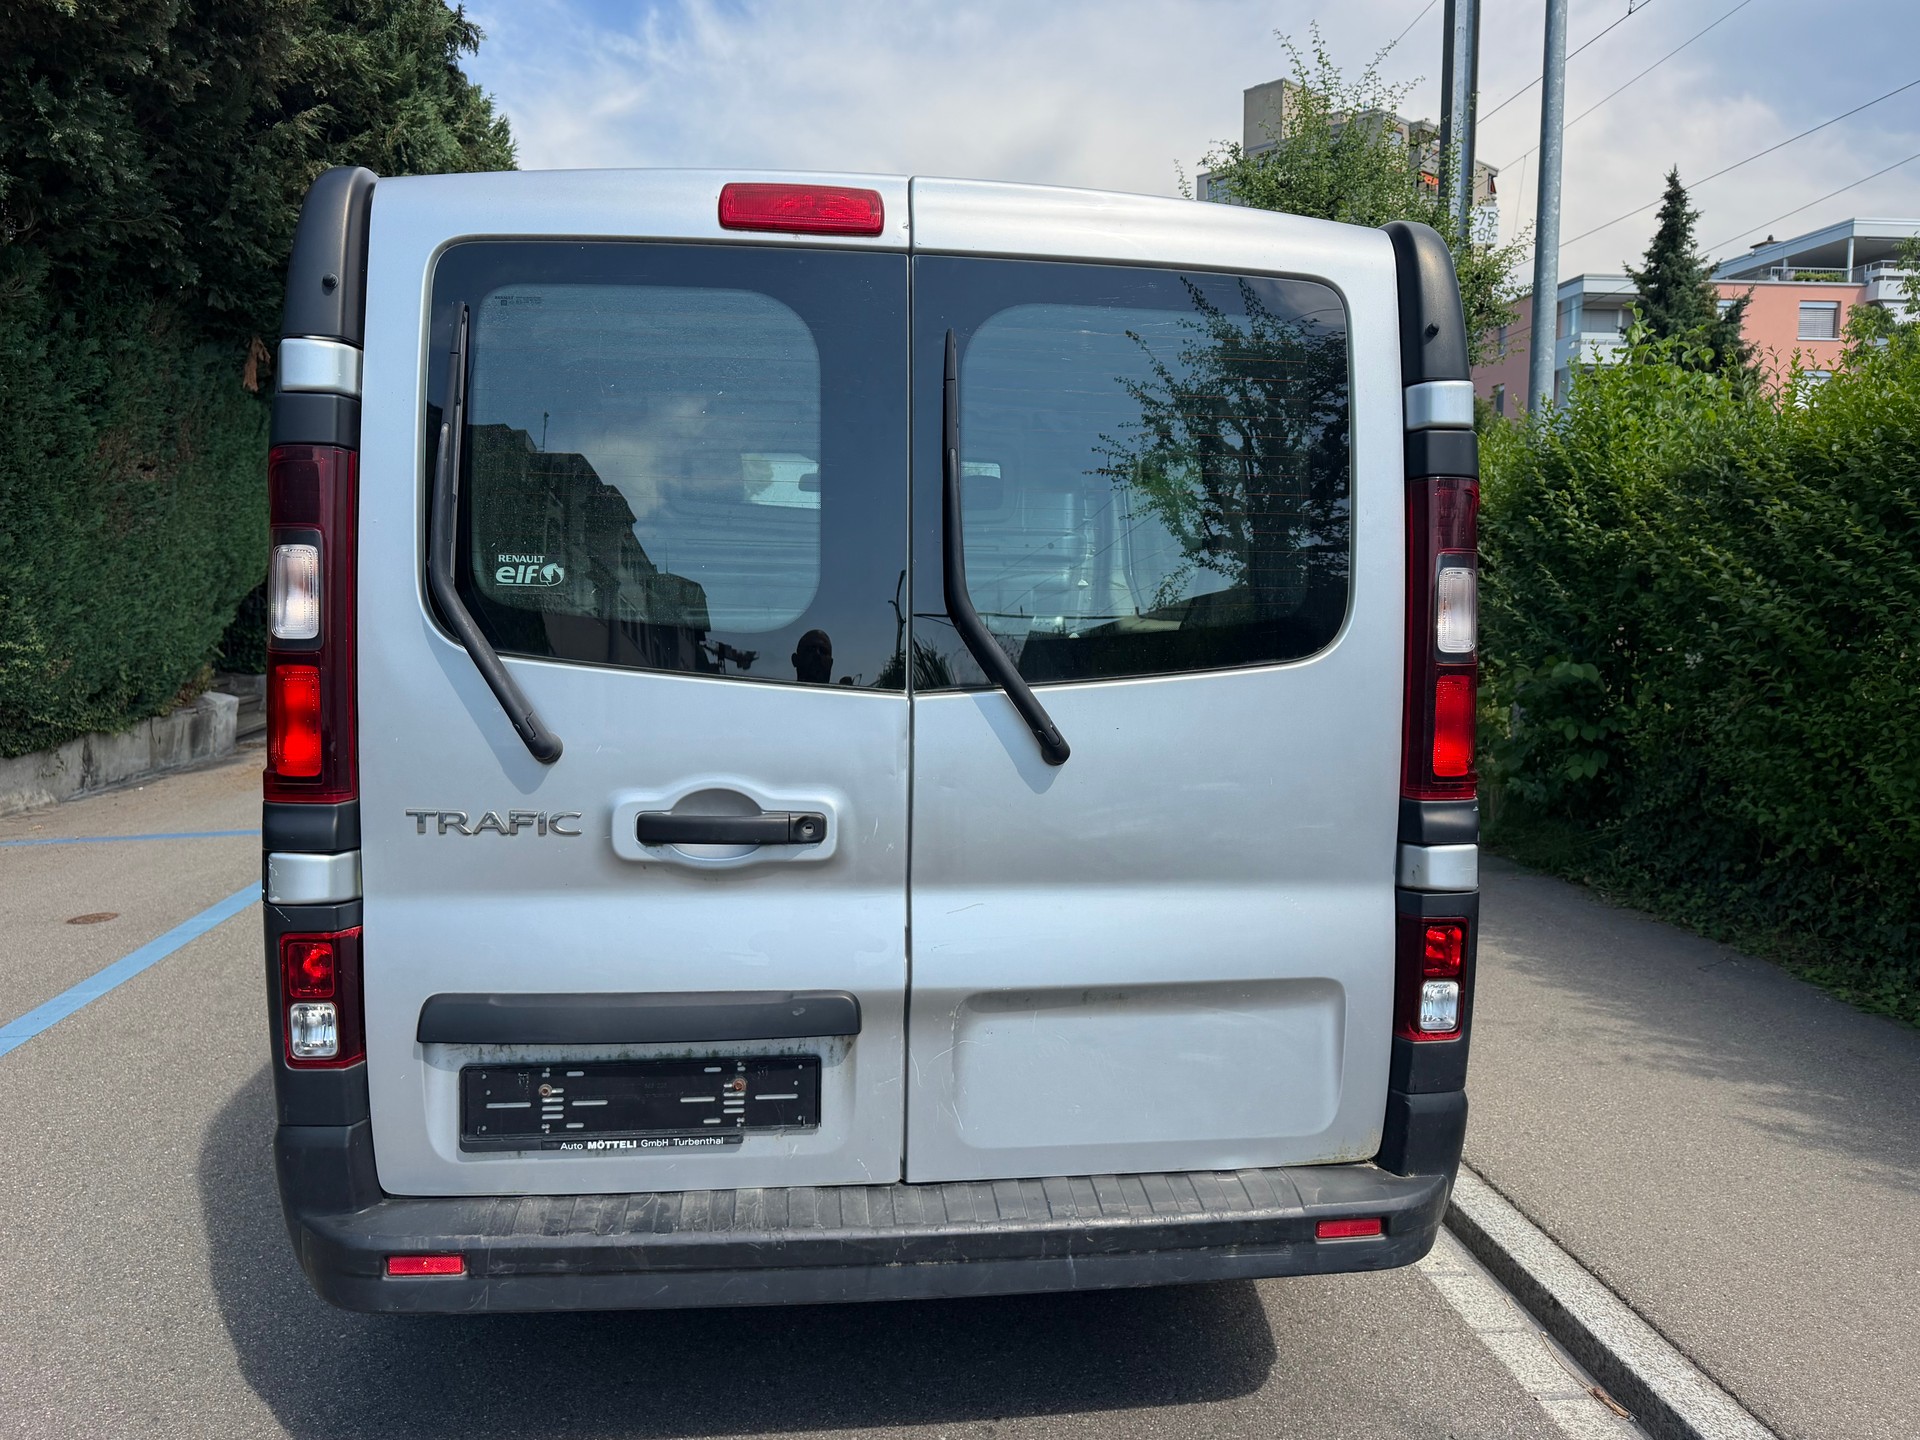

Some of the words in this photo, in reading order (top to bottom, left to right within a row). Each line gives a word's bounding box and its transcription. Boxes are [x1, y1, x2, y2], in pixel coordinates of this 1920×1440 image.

[498, 554, 545, 564] RENAULT
[495, 564, 540, 584] elf
[405, 808, 583, 836] TRAFIC
[560, 1142, 584, 1151] Auto
[587, 1139, 637, 1150] MÖTTELI
[640, 1138, 669, 1148] GmbH
[673, 1136, 724, 1147] Turbenthal
